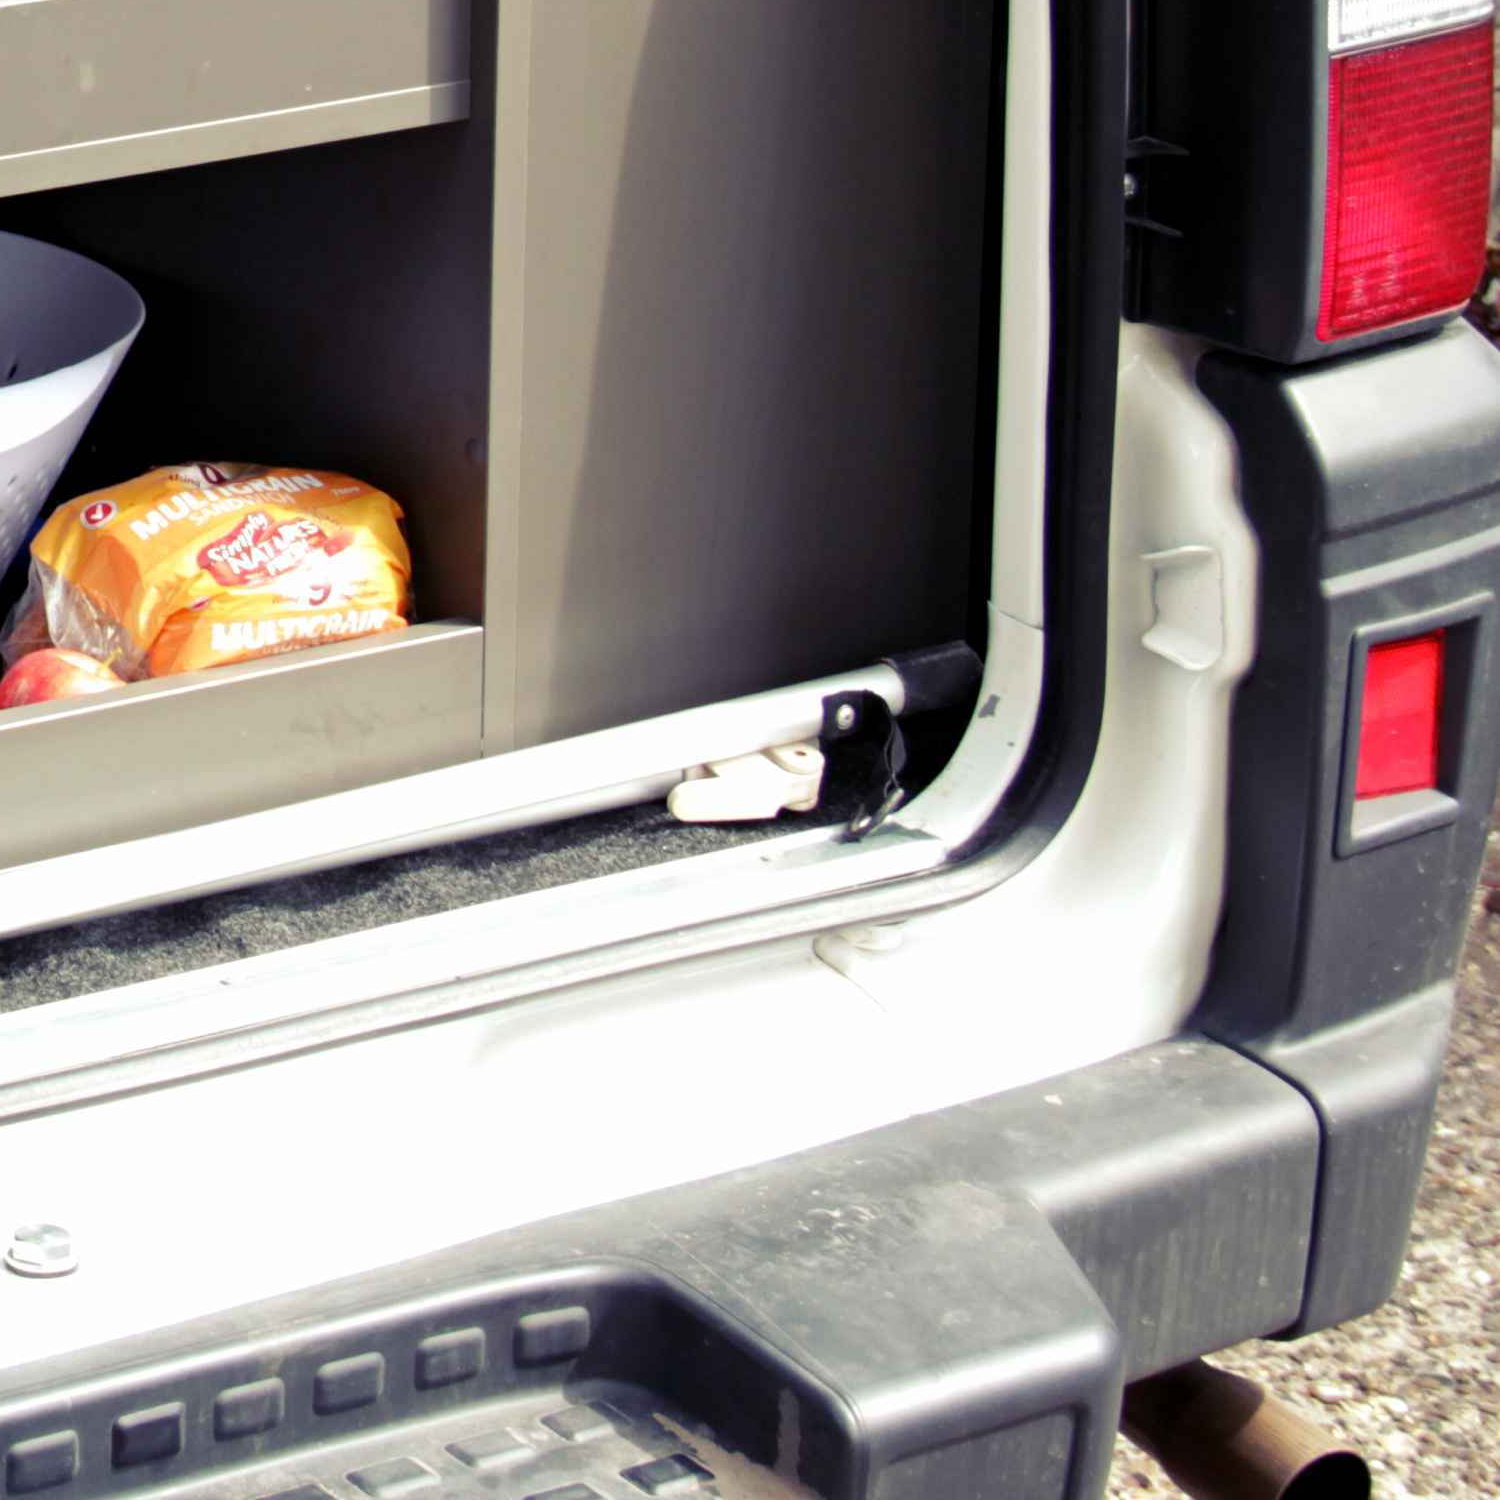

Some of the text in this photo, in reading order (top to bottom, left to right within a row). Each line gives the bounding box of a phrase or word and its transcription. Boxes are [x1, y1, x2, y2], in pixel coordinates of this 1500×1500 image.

[129, 473, 324, 541] MULTIGRAIN
[207, 512, 269, 563] Simply
[211, 610, 390, 651] MULTIGRAIN
